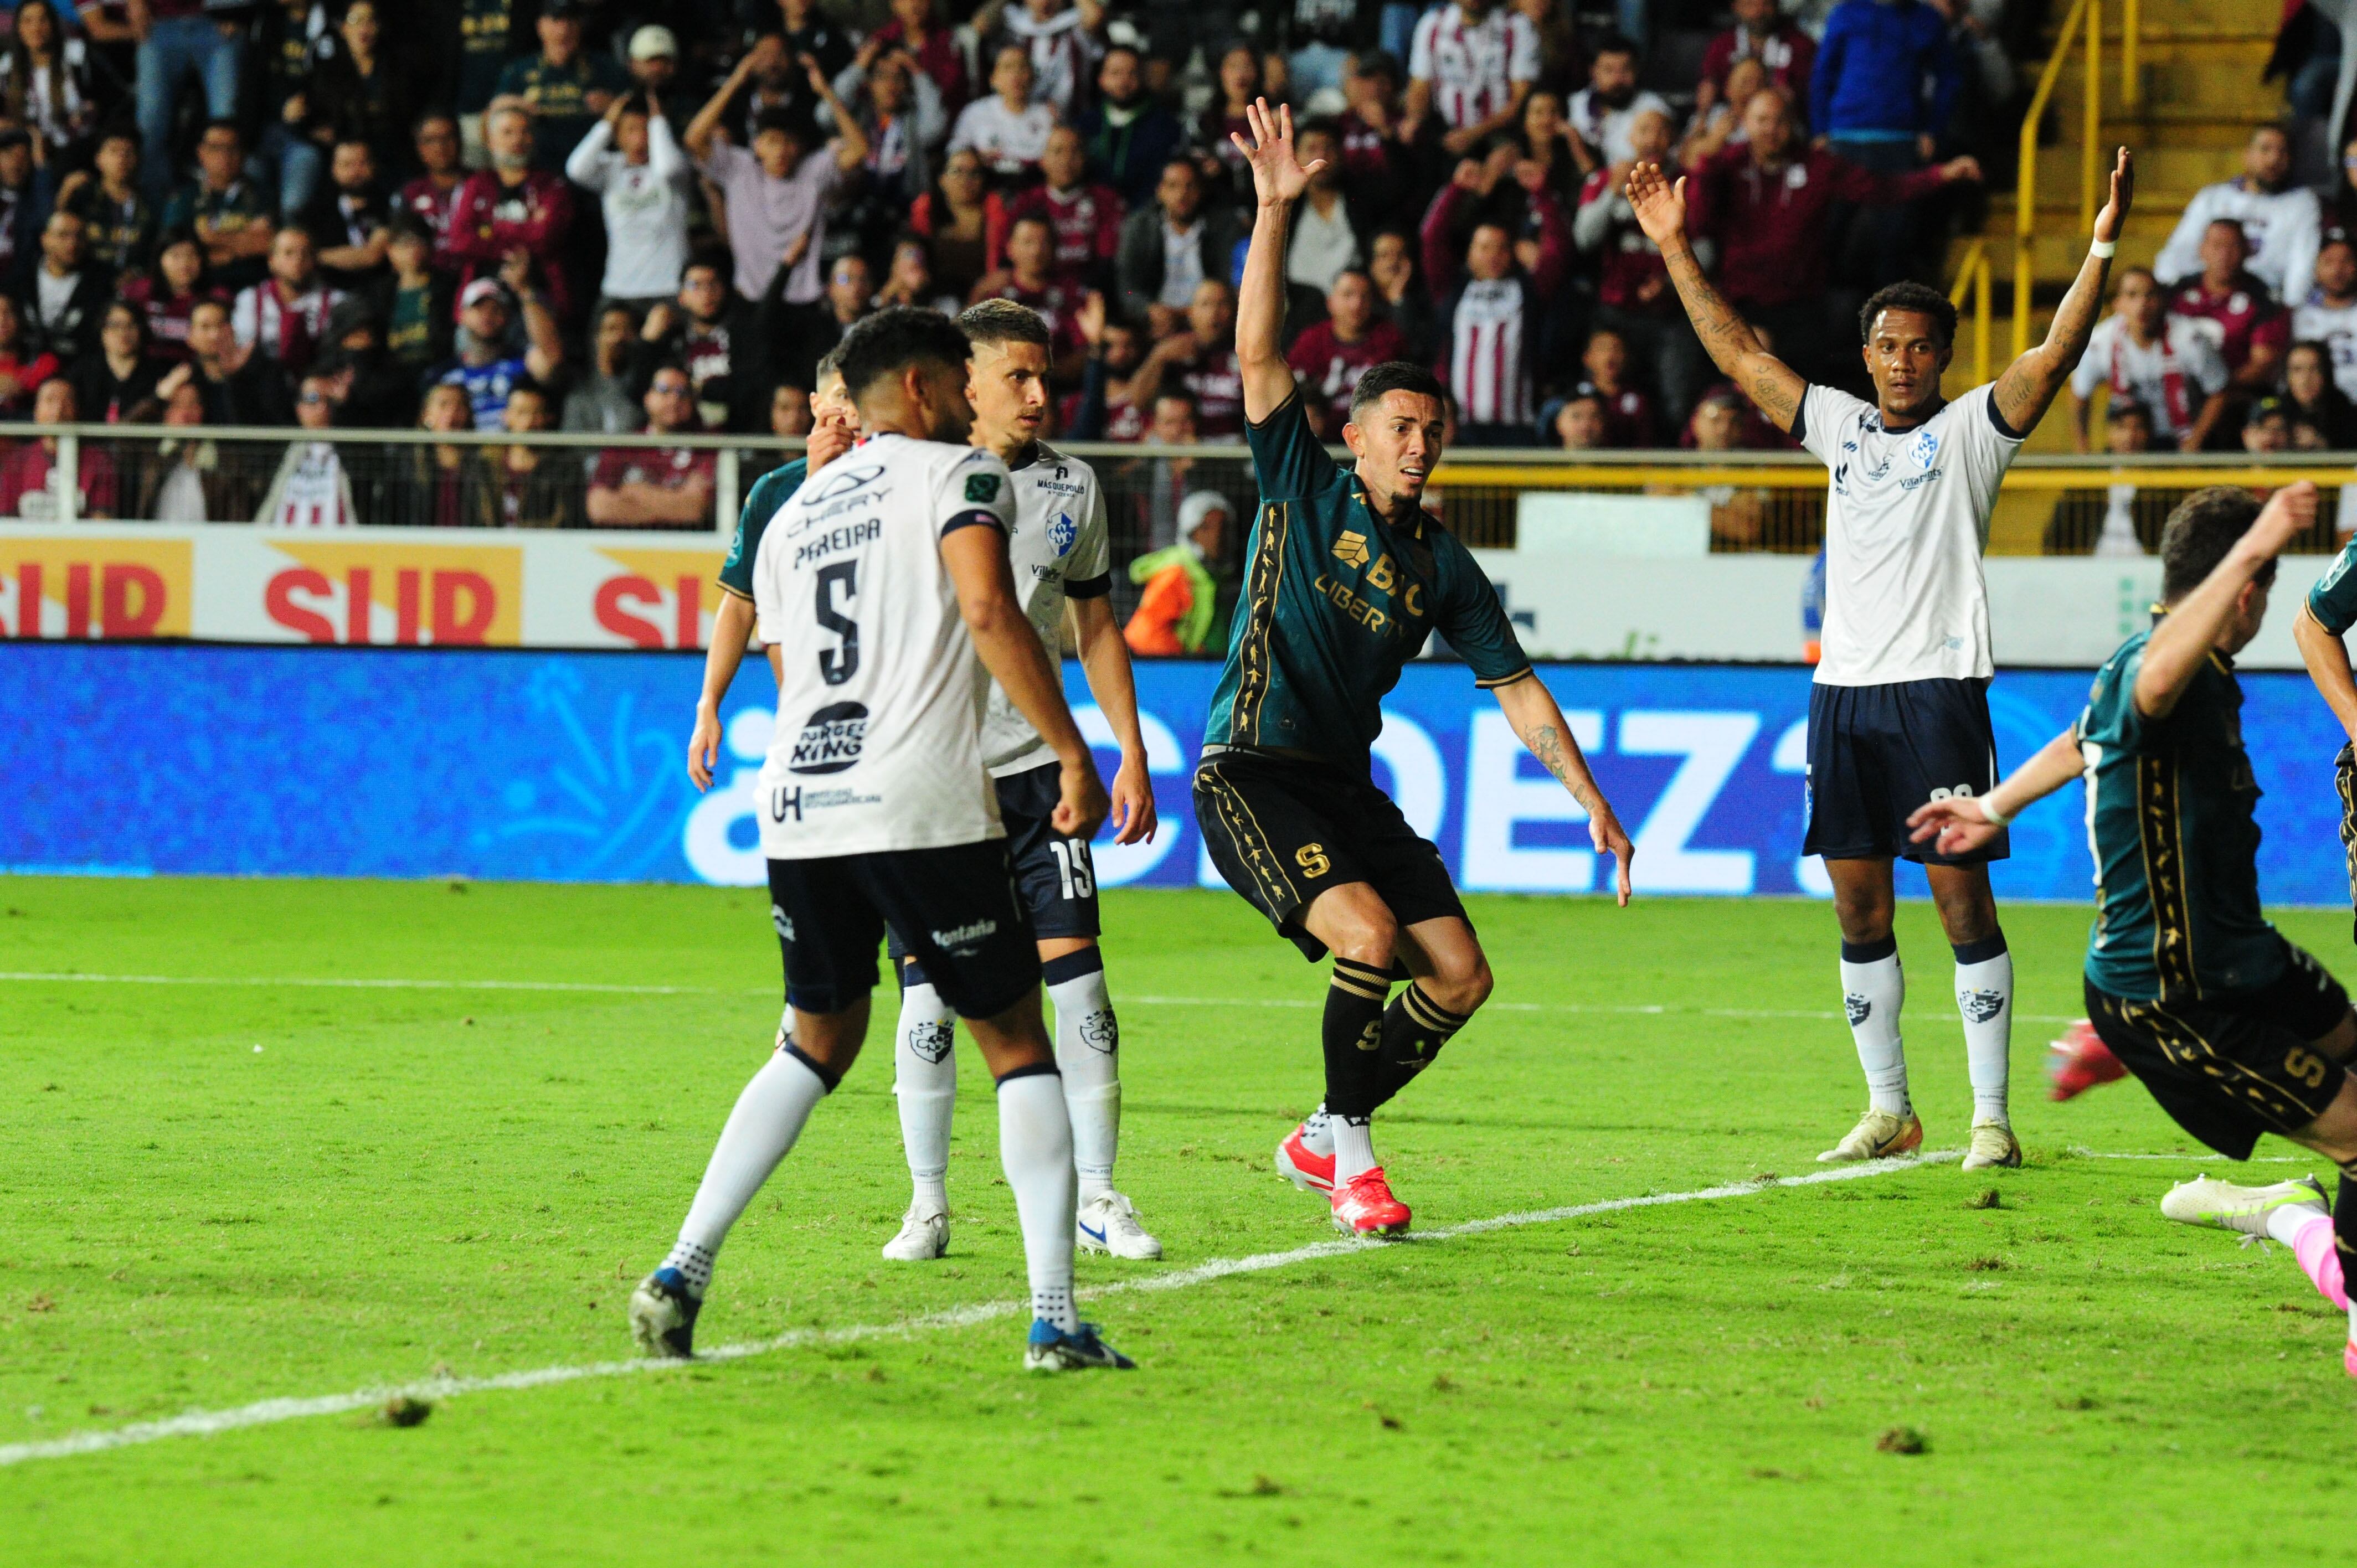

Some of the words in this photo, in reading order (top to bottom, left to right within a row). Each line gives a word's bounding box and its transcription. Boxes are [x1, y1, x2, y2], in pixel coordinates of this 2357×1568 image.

[787, 486, 894, 539] CHERY
[794, 518, 881, 570] PEREIRA
[0, 561, 167, 637] UR
[1366, 553, 1424, 617] BC
[815, 558, 860, 686] 5
[1049, 838, 1093, 900] 15
[1295, 843, 1331, 878] S
